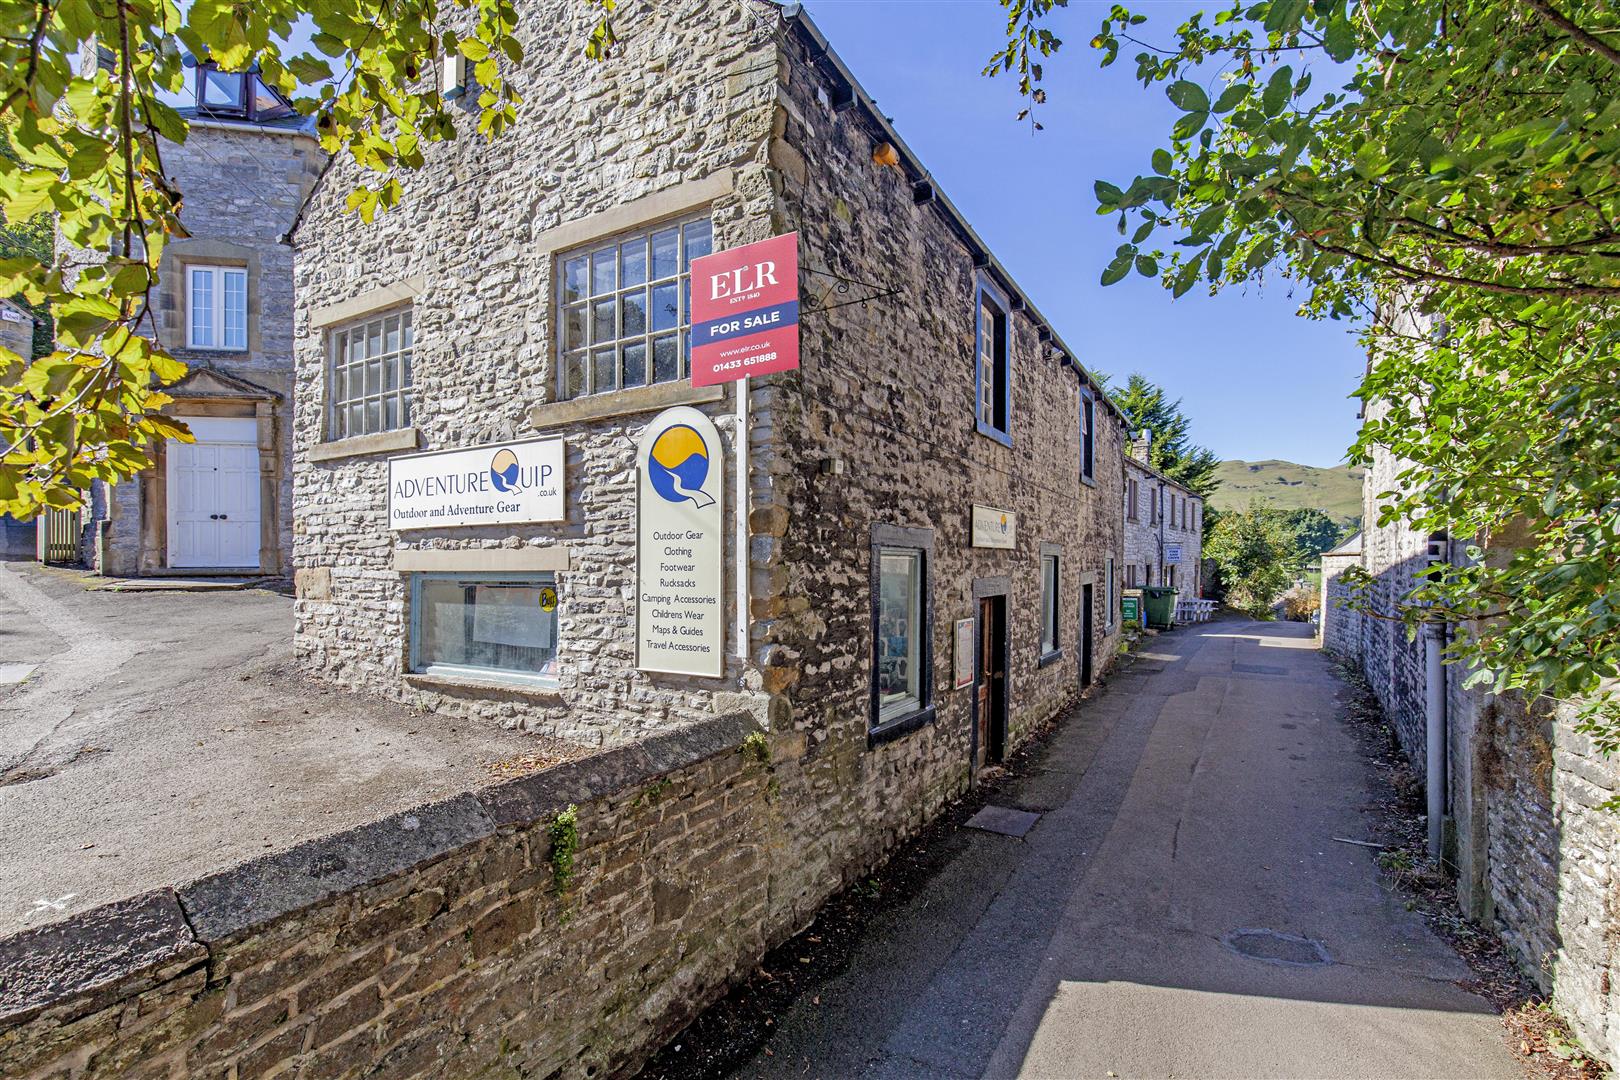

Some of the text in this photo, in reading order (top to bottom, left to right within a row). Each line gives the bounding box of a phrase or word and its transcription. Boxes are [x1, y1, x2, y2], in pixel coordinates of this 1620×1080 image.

[710, 261, 778, 300] ELR
[710, 310, 780, 337] FOR SALE
[719, 340, 771, 358] www.elr.co.uk
[712, 352, 777, 373] 01433 651888
[537, 487, 557, 498] .co.uk
[393, 501, 521, 520] Outdoor and Adventure Gear
[653, 530, 704, 541] Outdoor Gear
[664, 546, 693, 558] Clothing
[660, 562, 695, 572] Footwear
[659, 578, 696, 588] Rucksacks
[641, 593, 717, 606] Camping Accessories
[651, 608, 705, 620] Childrens Wear
[652, 624, 704, 636] Maps & Guides
[646, 639, 711, 653] Travel Accessories
